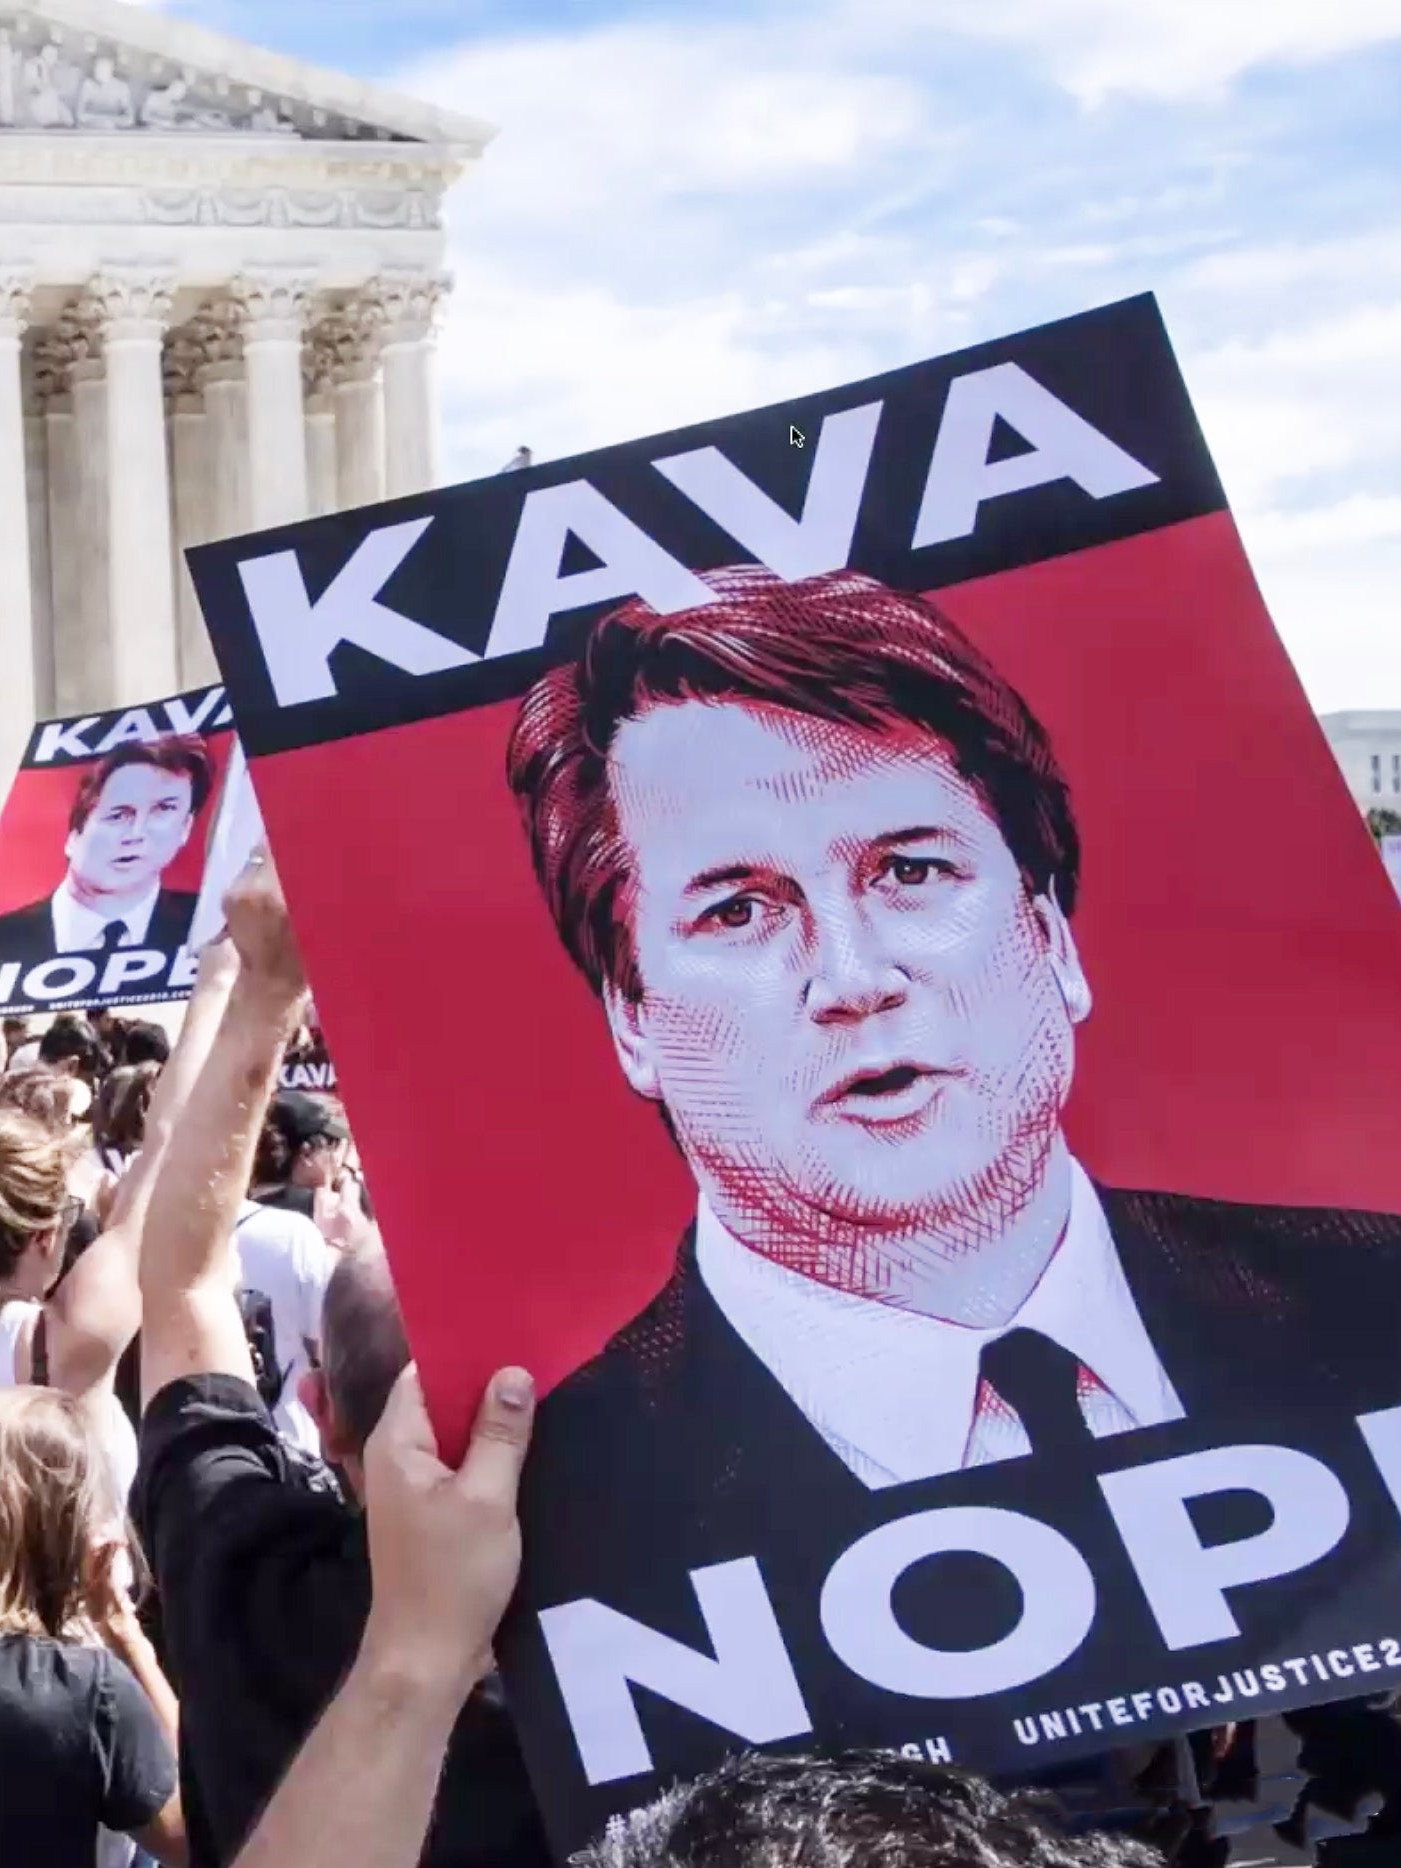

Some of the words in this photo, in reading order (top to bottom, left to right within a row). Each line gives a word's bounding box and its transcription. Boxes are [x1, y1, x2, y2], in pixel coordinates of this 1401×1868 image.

[236, 361, 1162, 708] KAVA
[33, 686, 234, 763] KAV
[537, 1406, 1401, 1786] NOP
[1013, 1638, 1401, 1746] UNITEFORJUSTICE2
